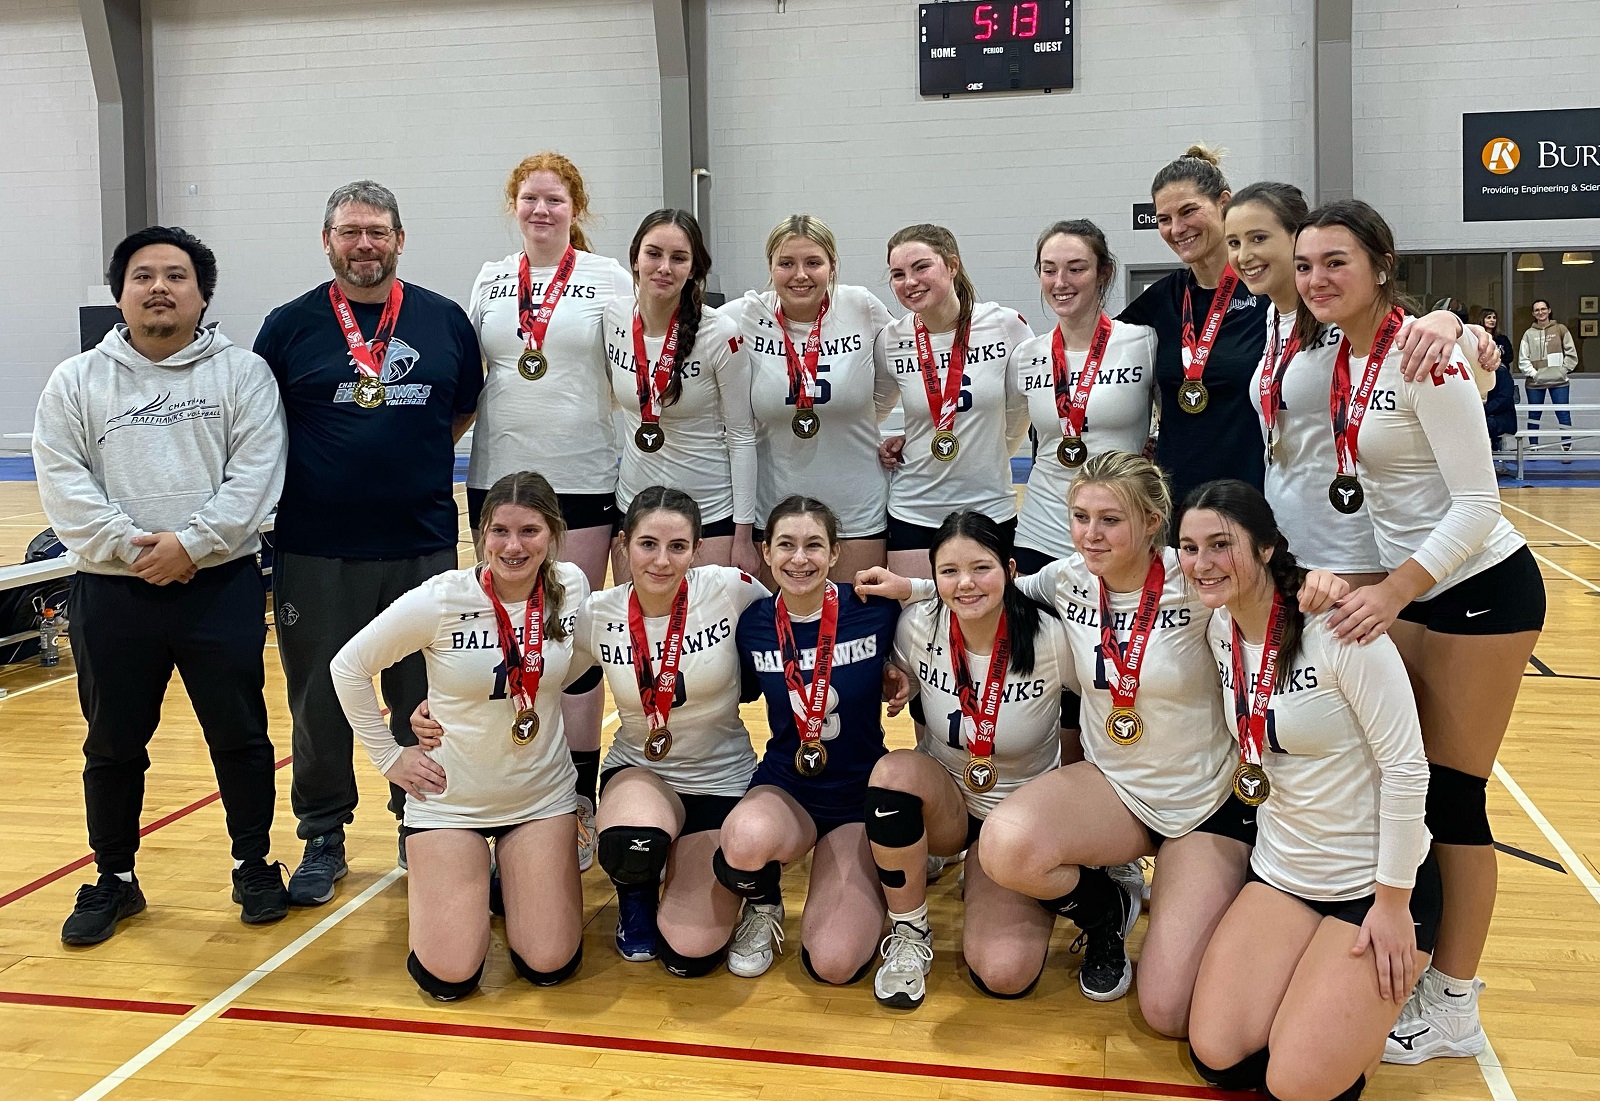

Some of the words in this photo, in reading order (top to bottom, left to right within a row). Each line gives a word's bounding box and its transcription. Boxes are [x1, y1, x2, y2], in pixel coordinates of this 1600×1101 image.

[973, 3, 1038, 40] 5:13
[931, 48, 956, 58] HOME
[983, 47, 1004, 55] PERIOD
[1034, 41, 1062, 53] GUEST
[1537, 141, 1600, 168] BUR
[1482, 186, 1519, 195] Providing
[1521, 184, 1569, 195] Engineering
[1571, 184, 1578, 192] &
[489, 283, 596, 299] BALHKS
[546, 281, 563, 304] Ontario
[557, 252, 575, 281] Volleyball
[337, 303, 354, 329] Ontario
[1202, 313, 1220, 342] Ontario
[1214, 276, 1234, 311] Volleyball
[609, 343, 701, 379] BALLKS
[754, 334, 861, 357] BALWKS
[895, 342, 1006, 374] BAHWKS
[1081, 361, 1097, 387] Ontario
[1091, 328, 1107, 359] Volleyball
[1360, 363, 1378, 398] Ontario
[1372, 317, 1398, 359] Volleyball
[917, 333, 929, 359] Ontario
[923, 360, 939, 394] Volleyball
[1025, 366, 1143, 390] BALHWKS
[333, 384, 432, 403] BAAWKS
[785, 365, 831, 405] 5
[187, 410, 221, 418] VOLLYBALL
[672, 592, 686, 631] Volleyball
[1066, 602, 1191, 630] BALHAKS
[452, 615, 576, 649] BALHKS
[529, 612, 540, 645] Ontario
[600, 617, 731, 665] BALHWKS
[1127, 635, 1144, 670] Ontario
[1138, 590, 1158, 633] Volleyball
[665, 634, 680, 667] Ontario
[751, 634, 877, 672] BALHWKS
[817, 635, 832, 676] Volleyball
[991, 638, 1008, 679] Volleyball
[1261, 650, 1277, 687] Ontario
[1269, 609, 1286, 648] Volleyba
[919, 661, 1045, 703] BALWKS
[1118, 690, 1134, 698] OVA
[1219, 661, 1318, 695] BAHKS
[812, 679, 826, 711] Ontario
[984, 682, 999, 716] Ontario
[1254, 708, 1265, 717] OVA
[977, 735, 991, 743] OVA
